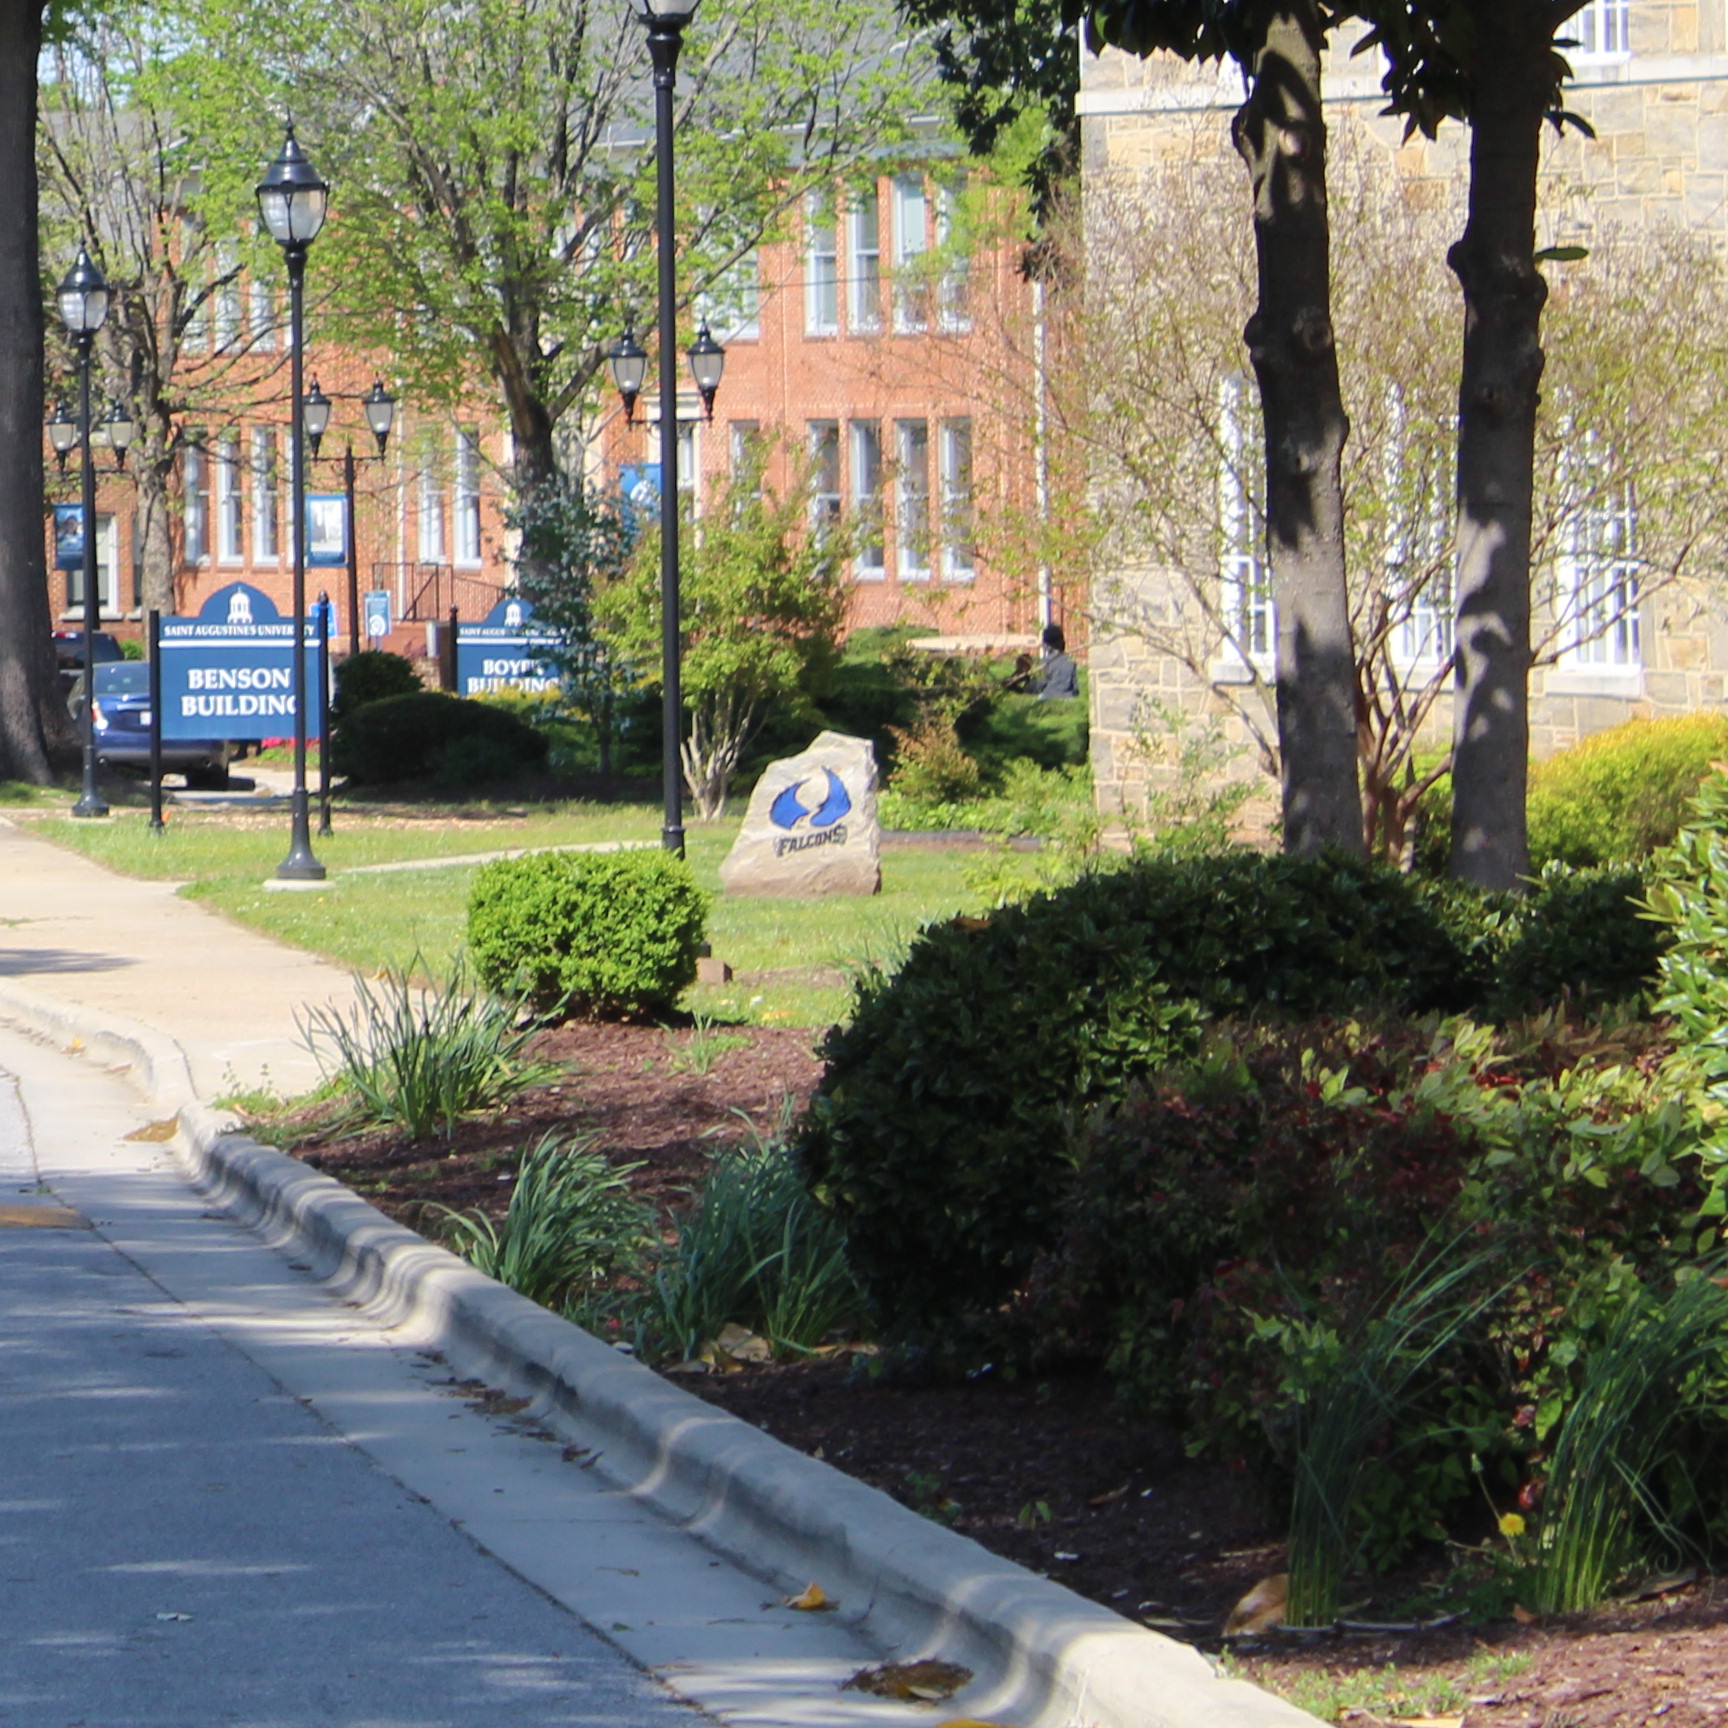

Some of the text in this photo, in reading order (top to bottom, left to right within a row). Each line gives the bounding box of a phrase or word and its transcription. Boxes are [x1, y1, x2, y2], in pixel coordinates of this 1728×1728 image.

[164, 624, 194, 636] SAINT
[187, 667, 291, 690] BENSON
[775, 823, 848, 858] FALCONS
